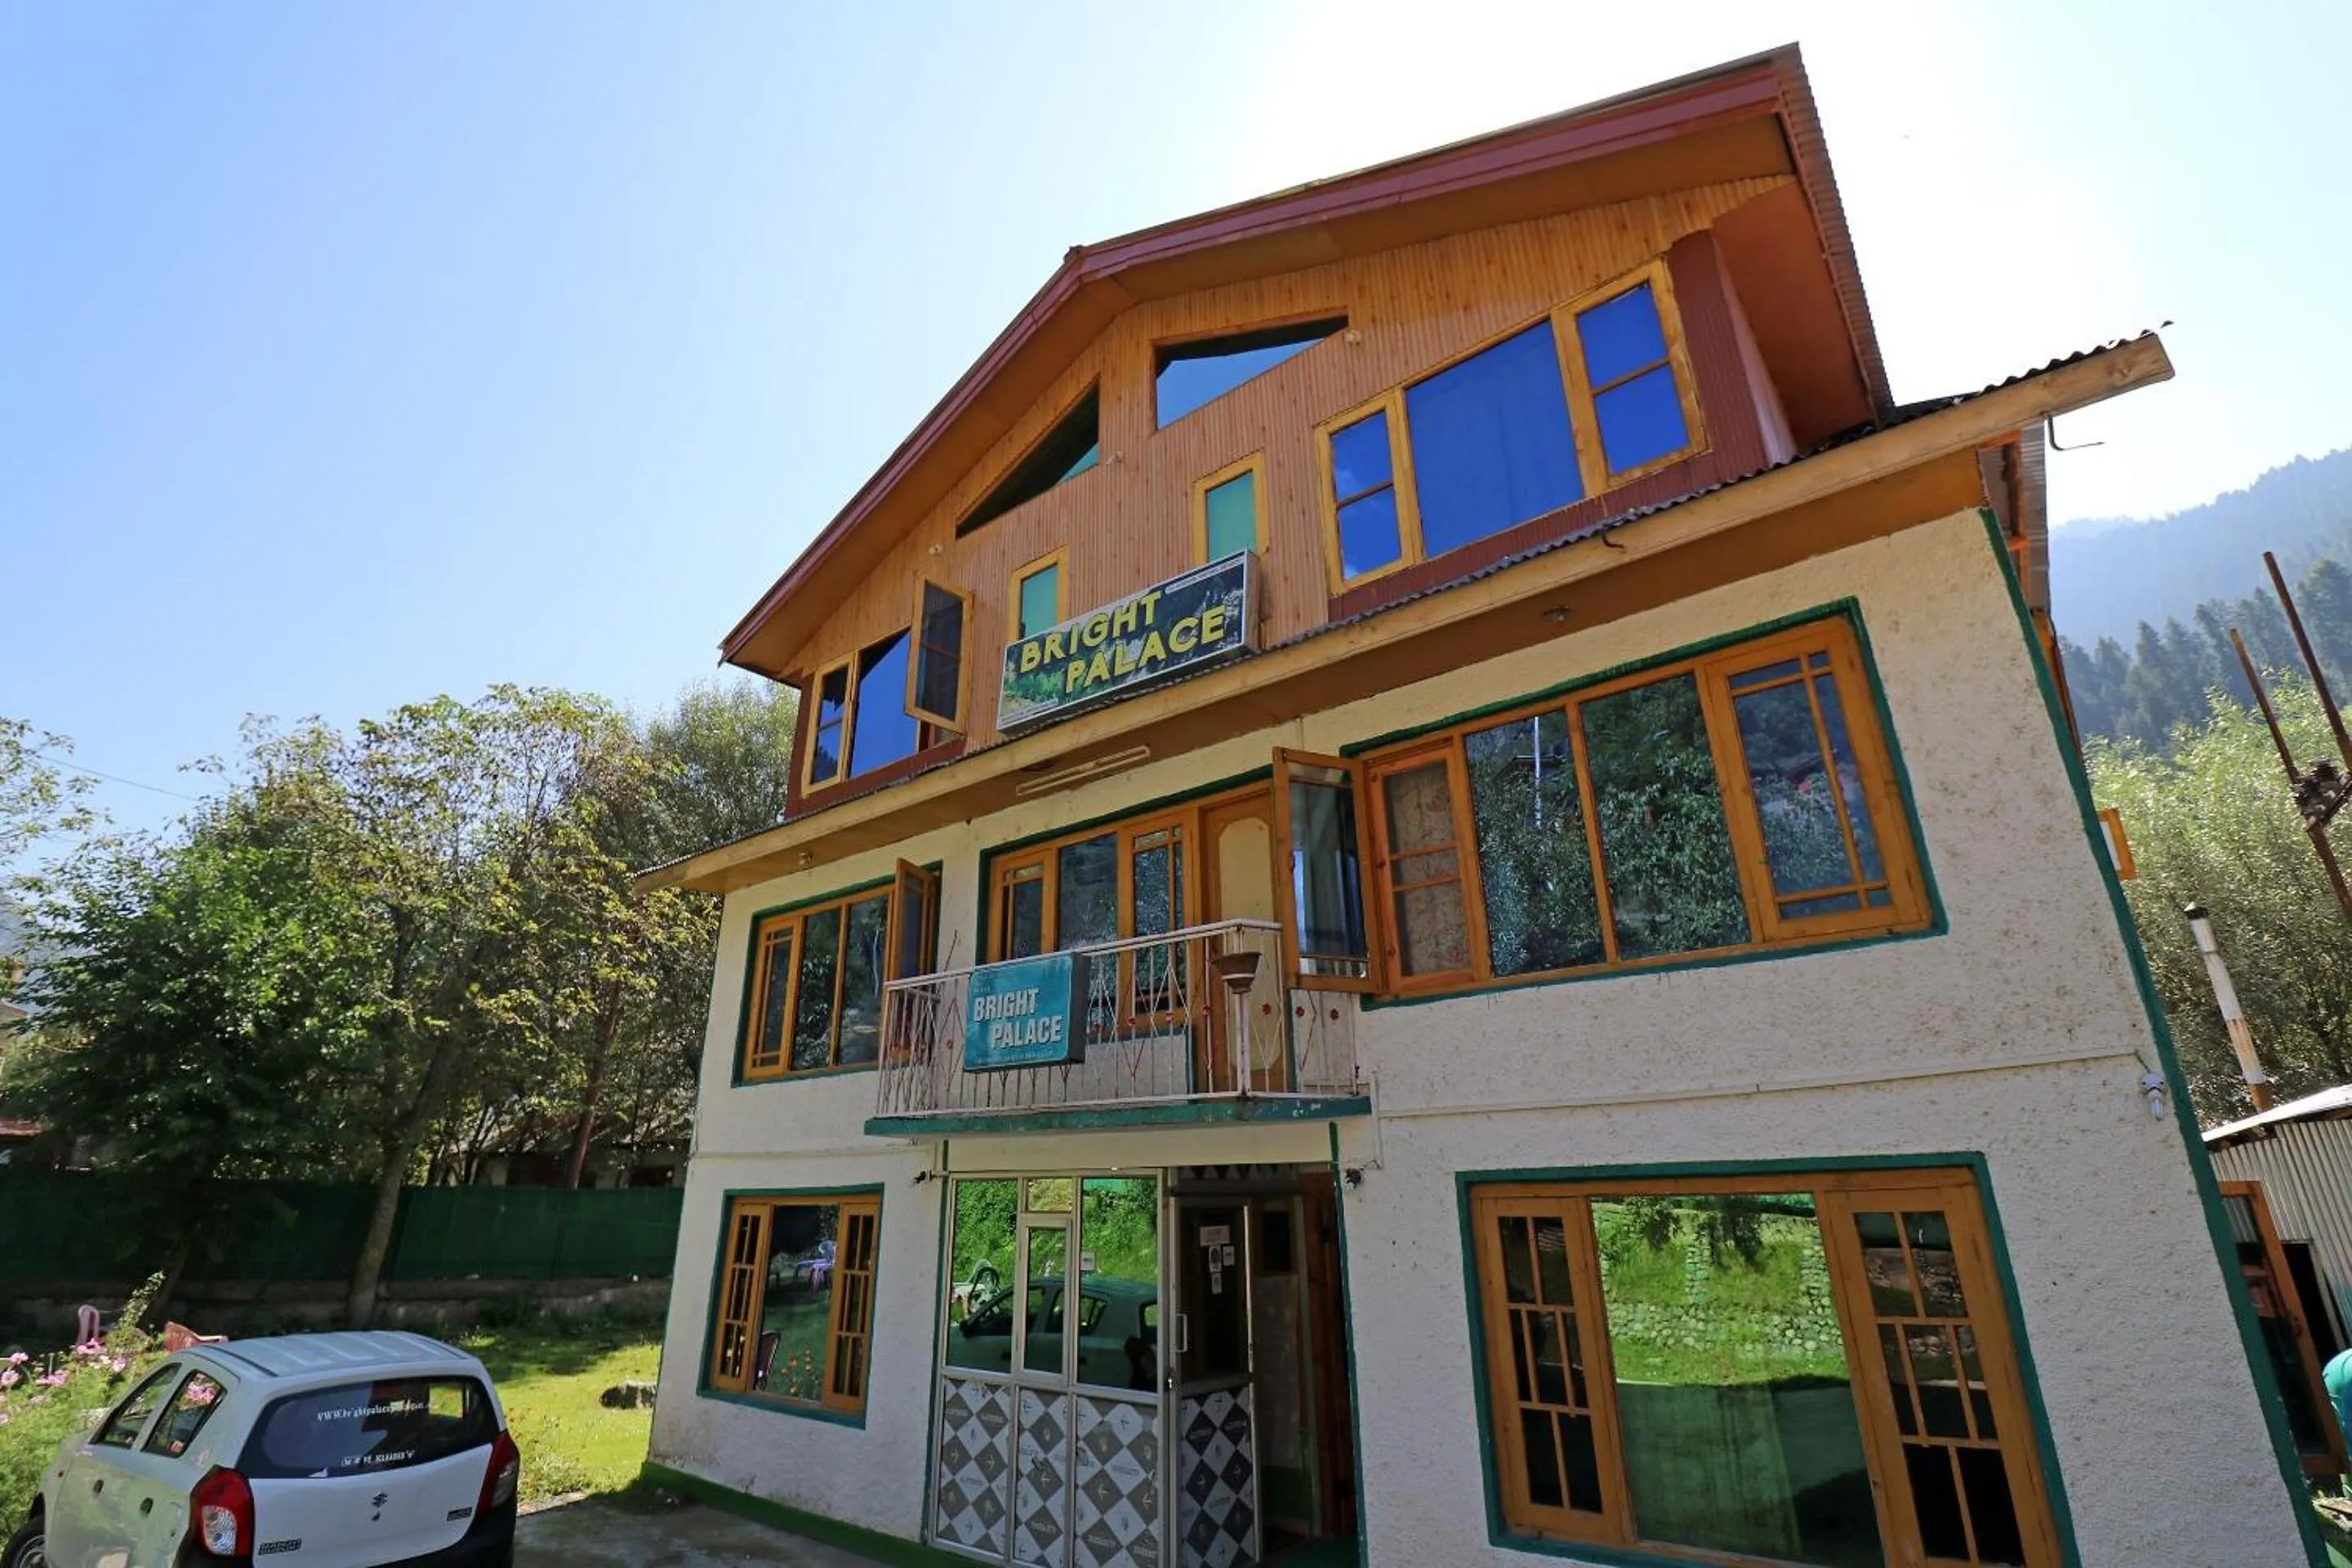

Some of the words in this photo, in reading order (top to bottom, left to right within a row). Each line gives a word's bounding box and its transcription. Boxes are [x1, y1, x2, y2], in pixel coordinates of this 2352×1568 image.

[1021, 590, 1162, 674] BRIGHT
[1065, 604, 1226, 694] PALACE
[973, 987, 1039, 1022] BRIGHT
[991, 1015, 1062, 1049] PALACE
